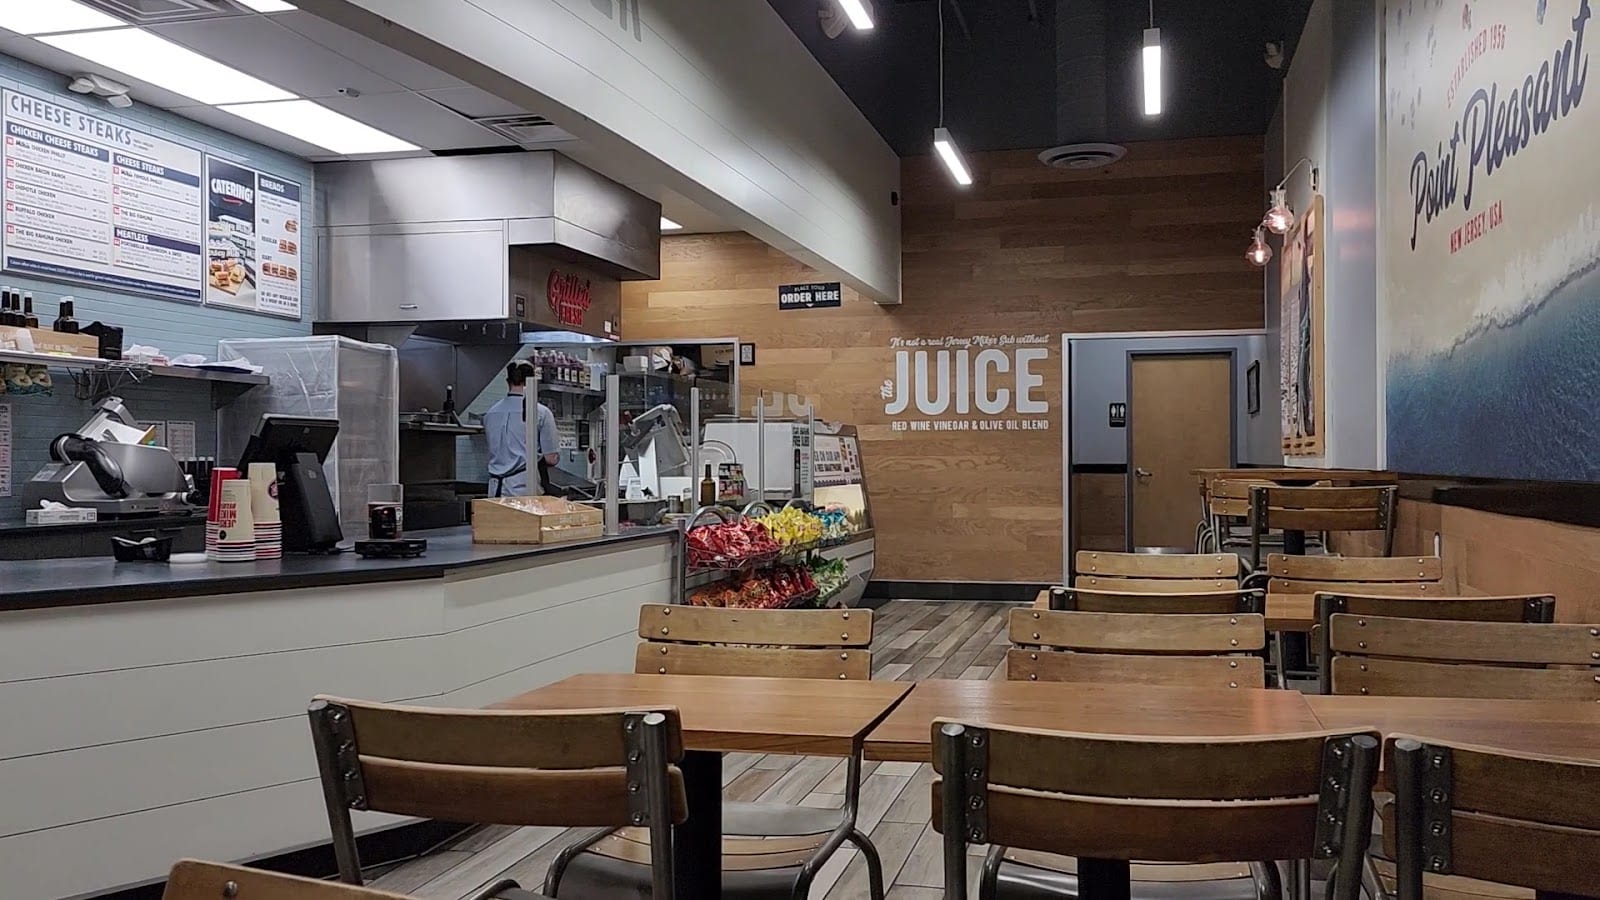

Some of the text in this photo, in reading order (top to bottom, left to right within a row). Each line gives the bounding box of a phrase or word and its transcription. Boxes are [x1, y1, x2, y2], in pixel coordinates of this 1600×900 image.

[1447, 24, 1506, 109] ESTABLISHED 1956
[11, 94, 132, 146] CHEESE STEAKS
[1410, 0, 1591, 251] Point Pleasant
[10, 124, 43, 142] CHICKEN
[45, 131, 73, 149] CHEESE
[73, 140, 99, 157] STEAKS
[116, 155, 141, 169] CHEESE
[141, 162, 165, 176] STEAKS
[211, 178, 254, 204] CATERING!
[260, 178, 285, 193] BREADS
[116, 228, 149, 243] MEATLESS
[1450, 226, 1462, 254] NEW
[1489, 199, 1503, 229] USA
[781, 290, 840, 304] ORDER HERE
[906, 337, 920, 346] not
[927, 336, 944, 346] real
[944, 336, 971, 349] Jersey
[972, 334, 998, 348] Mike's
[998, 334, 1016, 346] Sub
[1016, 334, 1050, 344] without
[880, 379, 894, 400] the
[884, 349, 1049, 416] JUICE
[892, 420, 1049, 431] RED WINE VINEGAR & OLIVE OIL BLEND
